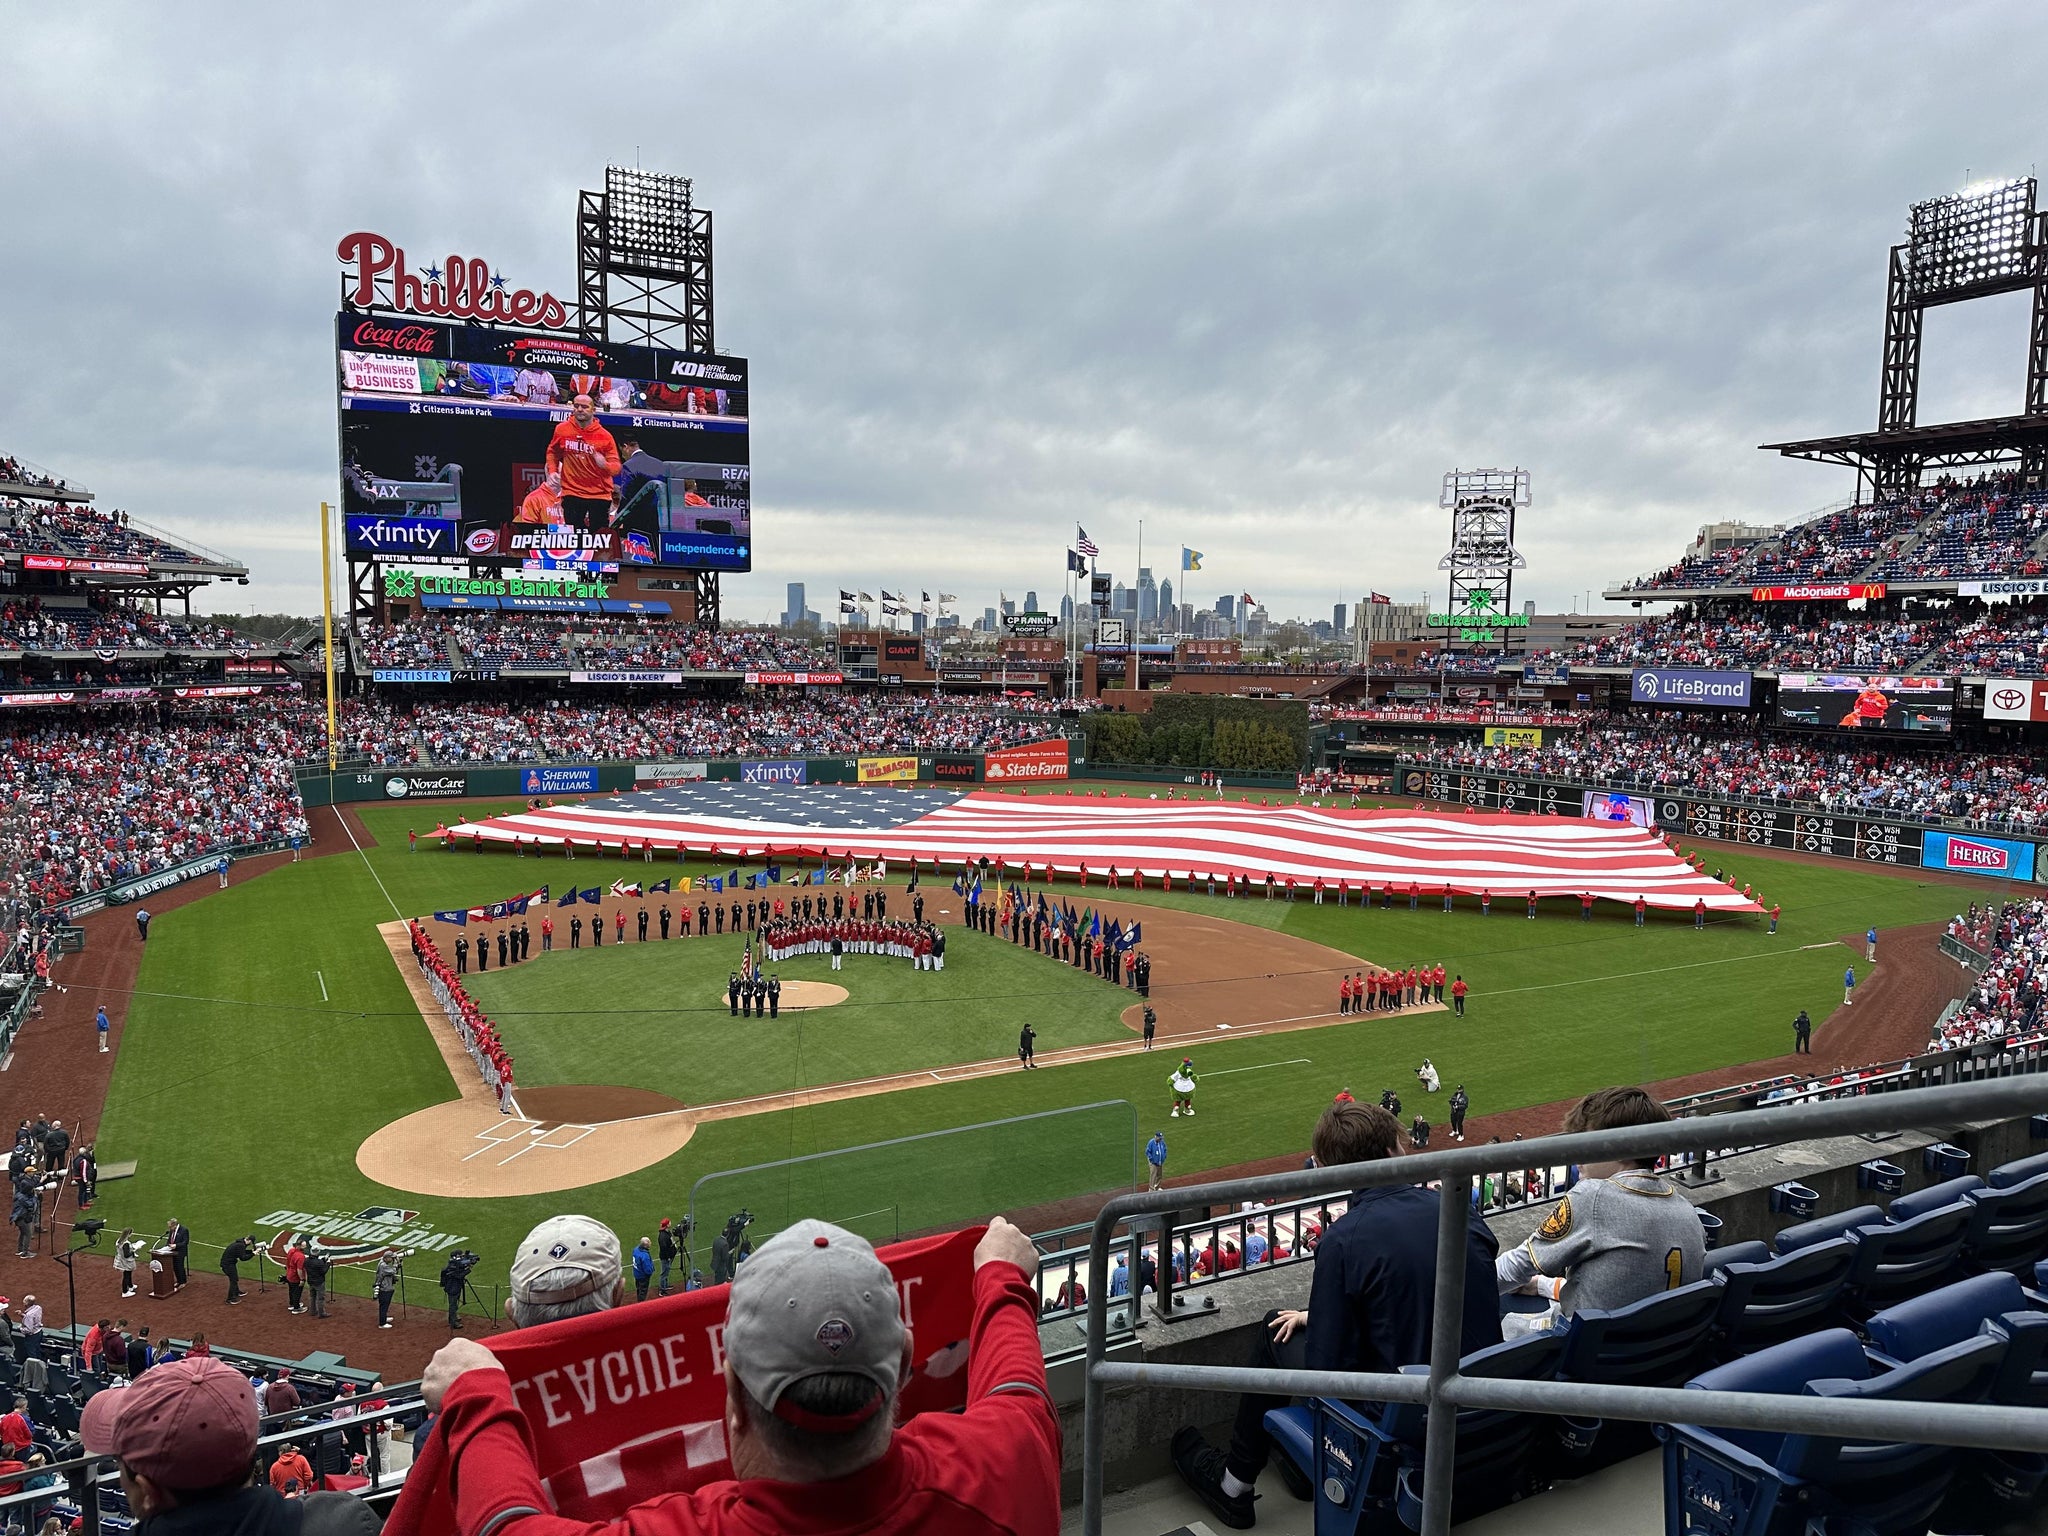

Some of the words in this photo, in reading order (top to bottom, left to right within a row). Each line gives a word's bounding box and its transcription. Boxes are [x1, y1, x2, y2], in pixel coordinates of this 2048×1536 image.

[337, 232, 567, 328] Phillies
[353, 321, 438, 353] Coca-Cola
[527, 340, 562, 350] PHILADELPHIA
[563, 343, 585, 352] PHILLIES
[532, 348, 559, 356] NATIONAL
[560, 351, 581, 359] LEAGUE
[524, 353, 589, 370] CHAMPIONS
[350, 362, 416, 377] UN-PHINISHED
[705, 363, 726, 374] OFFICE
[703, 371, 743, 382] TECHNOLOGY
[356, 375, 414, 390] BUSINESS
[423, 404, 454, 414] Citizens
[455, 407, 475, 416] Bank
[475, 408, 492, 417] Park
[644, 419, 671, 428] Citizens
[672, 420, 689, 429] Bank
[690, 421, 704, 430] Park
[358, 520, 441, 549] xfinity
[472, 535, 496, 546] REDS
[511, 534, 578, 550] OPENING
[582, 534, 612, 548] DAY
[665, 542, 735, 555] Independence
[372, 553, 411, 564] NUTRITION,
[411, 554, 438, 564] MORGAN
[441, 556, 469, 565] GREGORY
[555, 561, 588, 571] $21,345
[420, 575, 506, 595] Citizens
[510, 579, 561, 597] Bank
[565, 581, 609, 599] Park
[1784, 586, 1850, 597] McDonald's
[1981, 582, 2040, 594] LISCIO'S
[513, 598, 552, 607] HARRY
[1427, 613, 1488, 627] Citizens
[1491, 613, 1530, 627] Bank
[1461, 628, 1495, 641] Park
[888, 646, 916, 655] GIANT
[374, 671, 448, 681] DENTISTRY
[452, 671, 467, 681] for
[470, 671, 497, 681] LIFE
[587, 672, 627, 681] LISCIO'S
[629, 672, 665, 681] BAKERY
[761, 674, 793, 682] TOYOTA
[807, 674, 841, 682] TOYOTA
[1664, 678, 1744, 697] LifeBrand
[1509, 732, 1534, 740] PLAY
[845, 760, 856, 768] 374
[921, 758, 932, 766] 387
[1074, 757, 1085, 765] 409
[543, 770, 590, 780] SHERWIN
[745, 763, 802, 783] xfinity
[935, 764, 974, 776] GIANT
[356, 774, 373, 784] 334
[409, 778, 465, 790] NovaCare
[1184, 775, 1195, 783] 401
[409, 788, 462, 797] REHABILITATION
[1762, 811, 1777, 820] CWS
[1823, 818, 1834, 826] SD
[1707, 830, 1720, 838] CHC
[1764, 829, 1773, 837] KC
[1822, 827, 1834, 836] ATL
[1884, 826, 1901, 834] WSH
[1821, 837, 1833, 845] STL
[1884, 835, 1898, 843] COL
[1820, 845, 1833, 854] MIL
[1883, 845, 1898, 853] LAD
[1884, 854, 1897, 863] ARI
[1952, 845, 2001, 866] HERR'S
[136, 885, 151, 897] MLB
[150, 873, 180, 892] NETWORK
[188, 865, 201, 878] MLB
[200, 858, 218, 874] NETWO
[253, 1209, 395, 1243] OPENING
[392, 1228, 469, 1251] DAY
